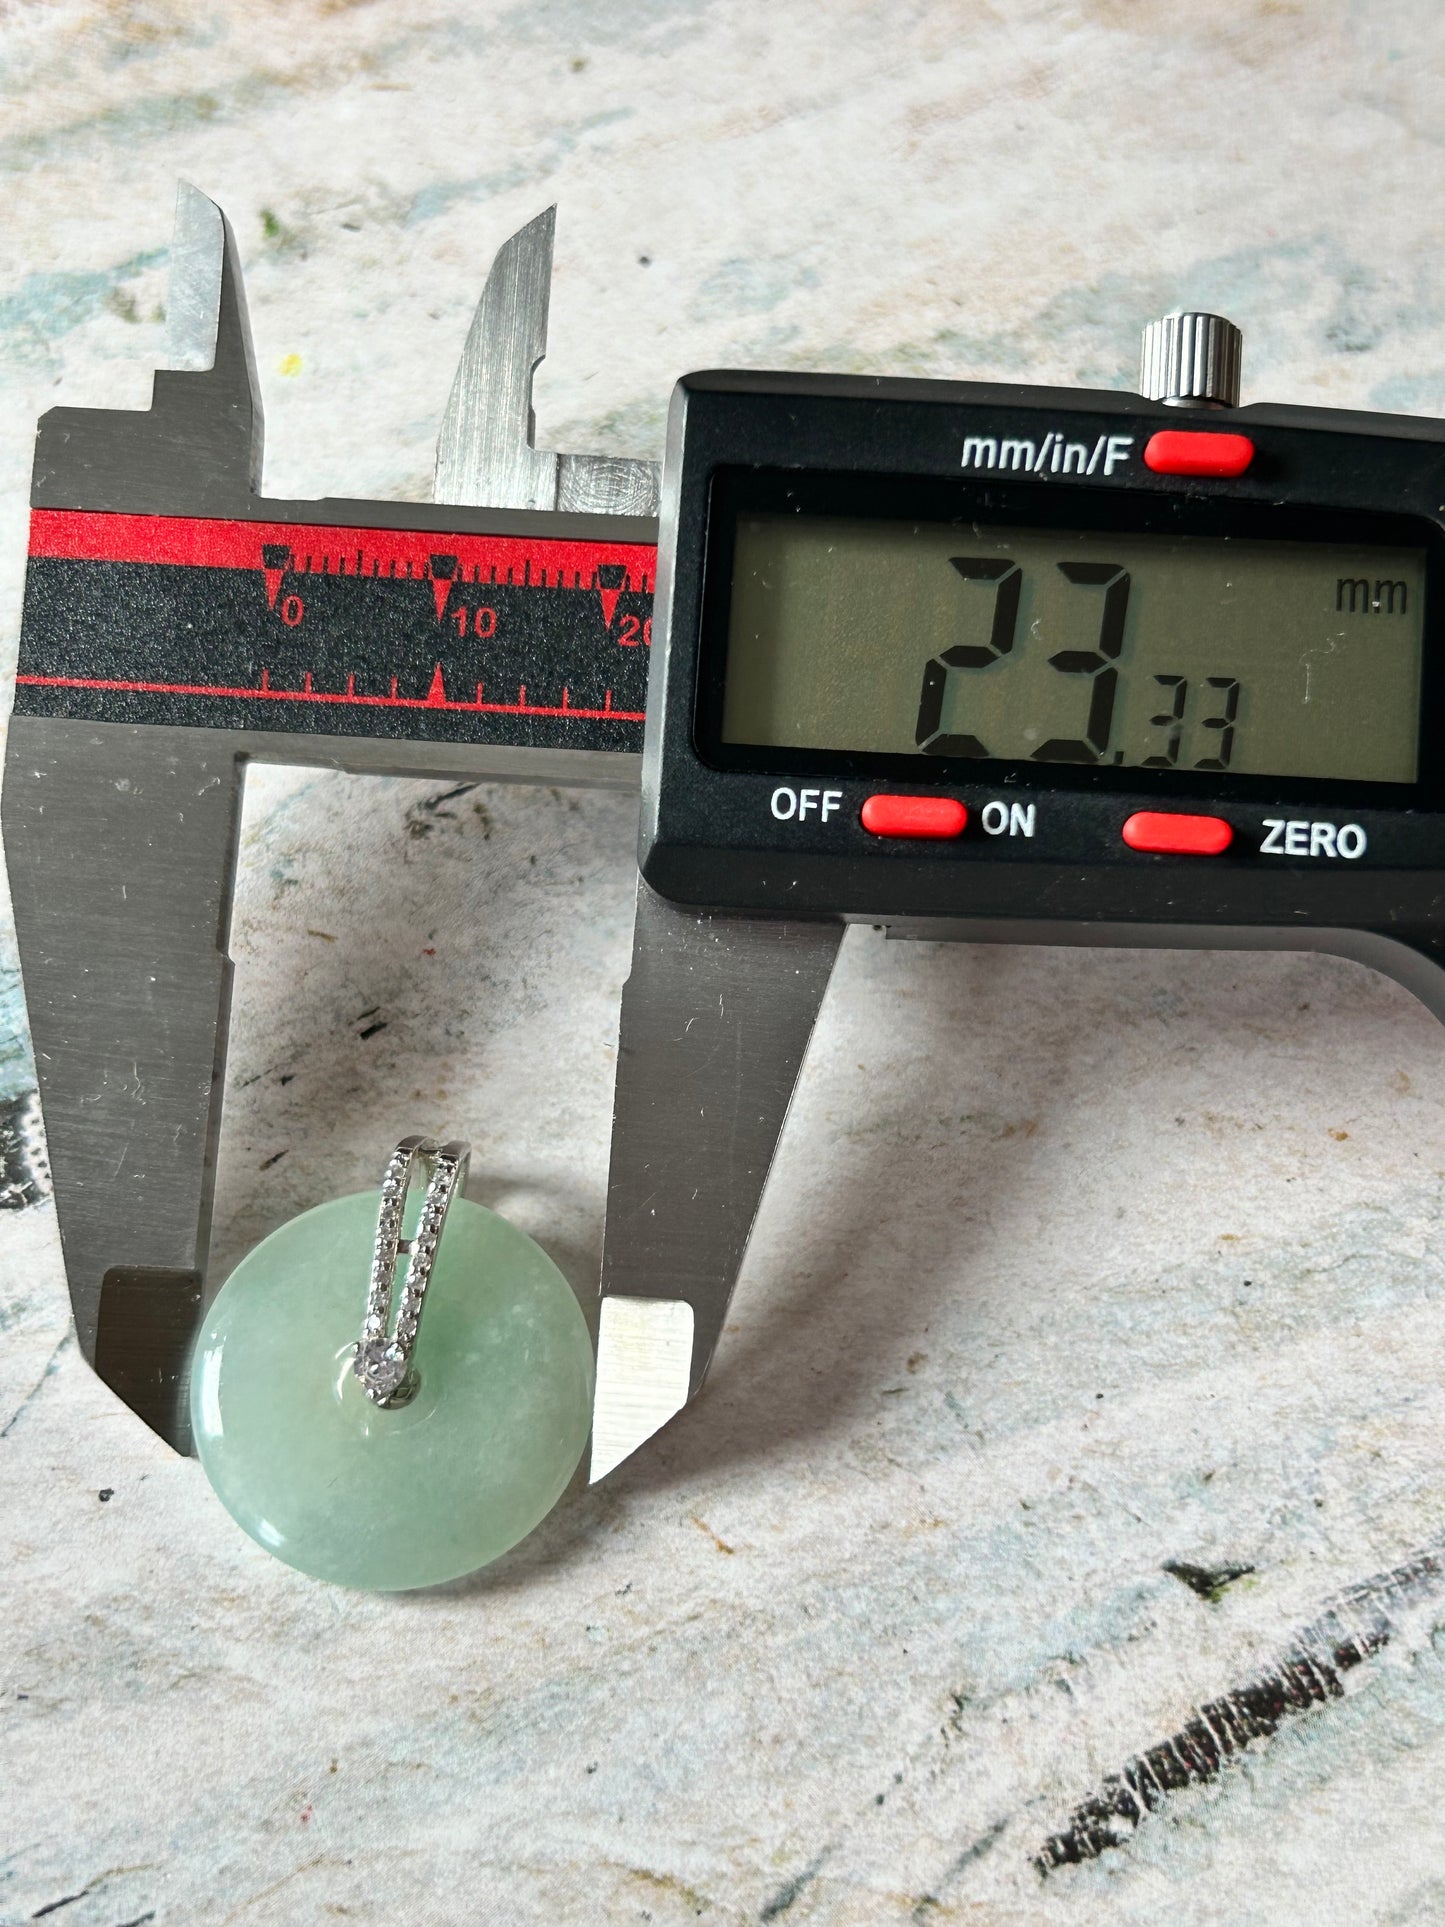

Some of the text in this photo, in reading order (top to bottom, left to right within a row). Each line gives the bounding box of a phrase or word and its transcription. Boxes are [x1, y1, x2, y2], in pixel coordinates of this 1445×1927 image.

[961, 433, 1134, 476] mm/in/F
[281, 595, 304, 627] 0
[1336, 577, 1408, 613] mm
[453, 607, 498, 639] 10
[915, 557, 1240, 770] 23.33
[770, 788, 843, 823] OFF
[980, 802, 1036, 838] ON
[1259, 818, 1368, 860] ZERO
